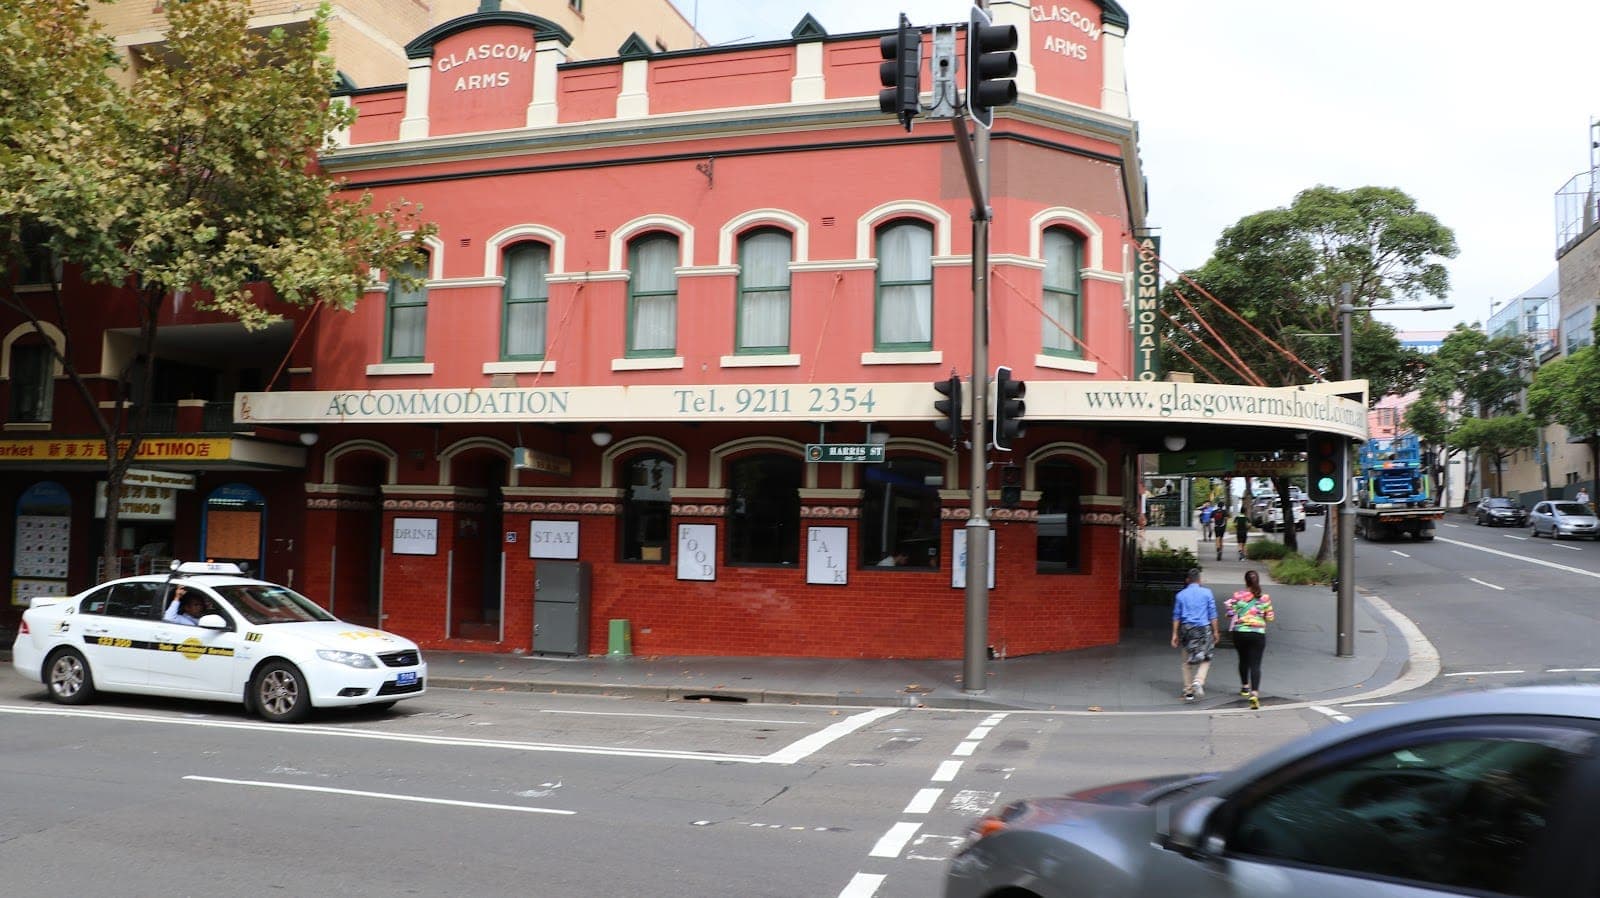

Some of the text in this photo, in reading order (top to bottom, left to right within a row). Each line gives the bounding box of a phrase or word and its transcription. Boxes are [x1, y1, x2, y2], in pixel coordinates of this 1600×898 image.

[1043, 35, 1088, 61] ARMS
[454, 71, 510, 92] ARMS
[326, 387, 875, 416] ACCOMMODATION Tel. 9211 2354
[829, 447, 883, 456] HARRIS ST
[395, 528, 435, 541] DRINK
[534, 531, 575, 544] STAY
[681, 527, 713, 576] FOOD
[809, 529, 845, 582] TALK
